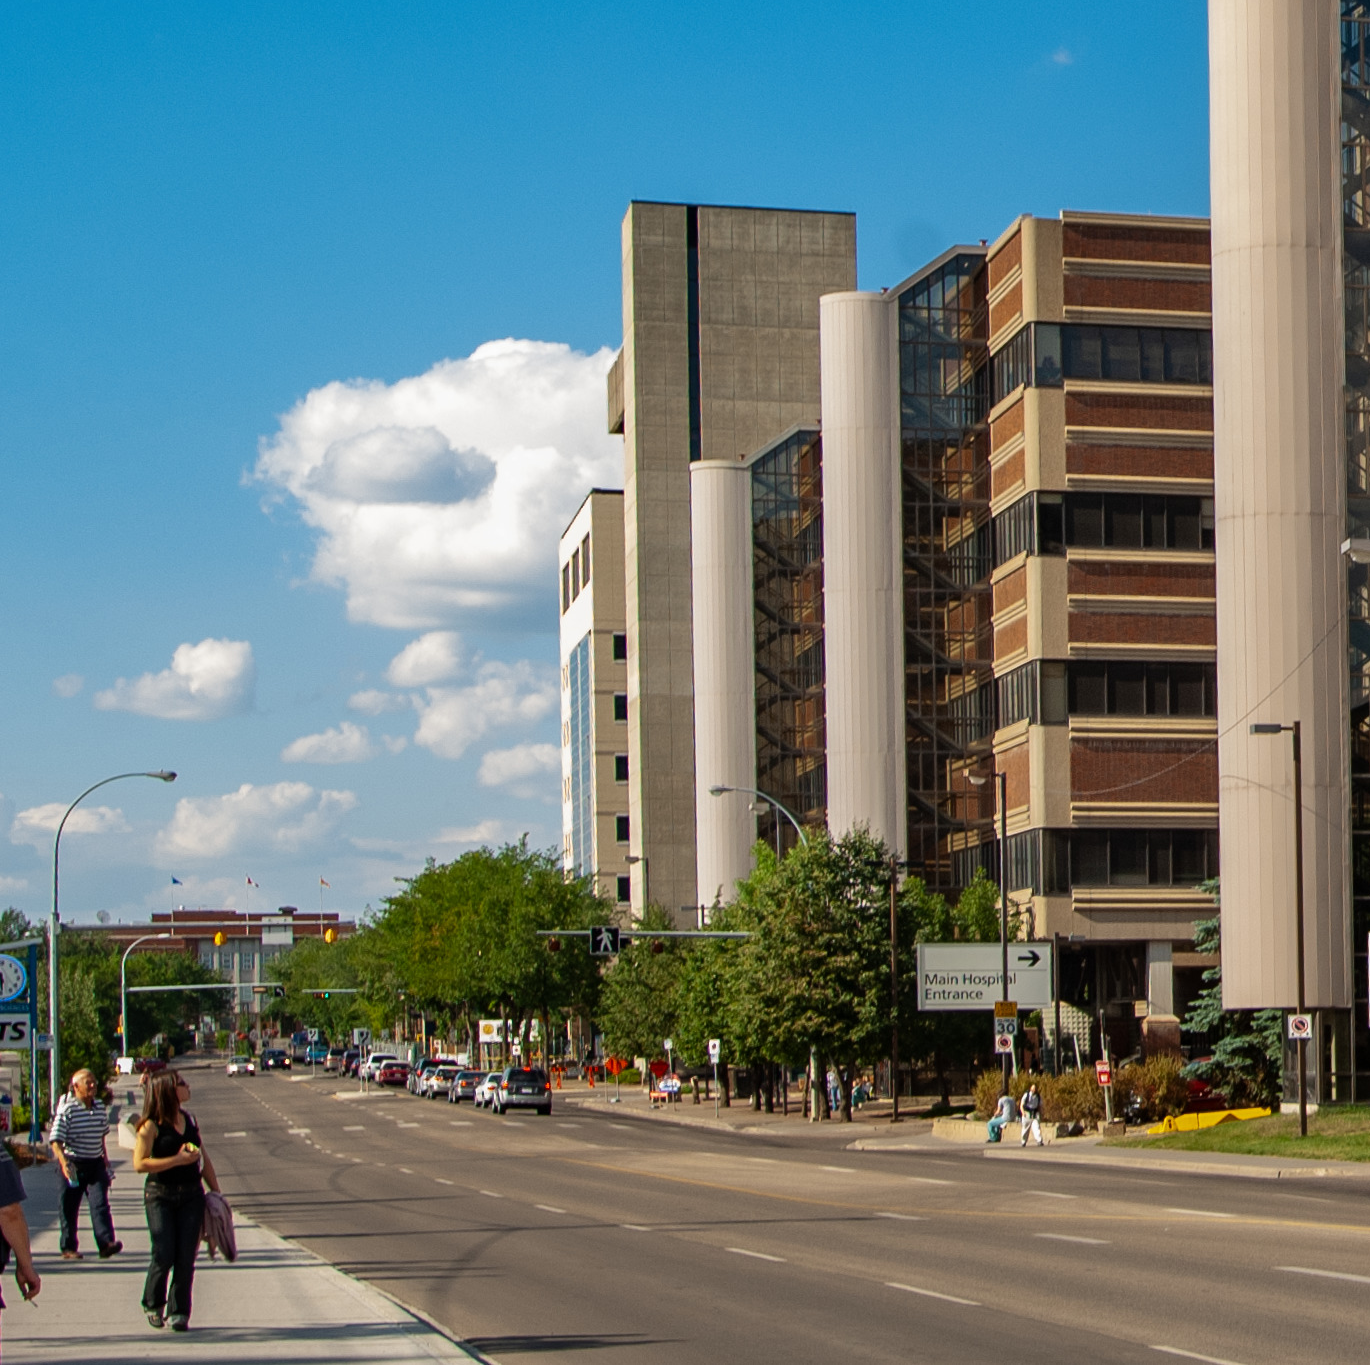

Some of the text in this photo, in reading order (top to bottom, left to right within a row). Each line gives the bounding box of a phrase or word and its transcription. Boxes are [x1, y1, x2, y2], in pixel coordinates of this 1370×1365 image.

[924, 973, 959, 985] Main
[924, 988, 984, 1000] Entrance
[997, 1022, 1016, 1034] 30
